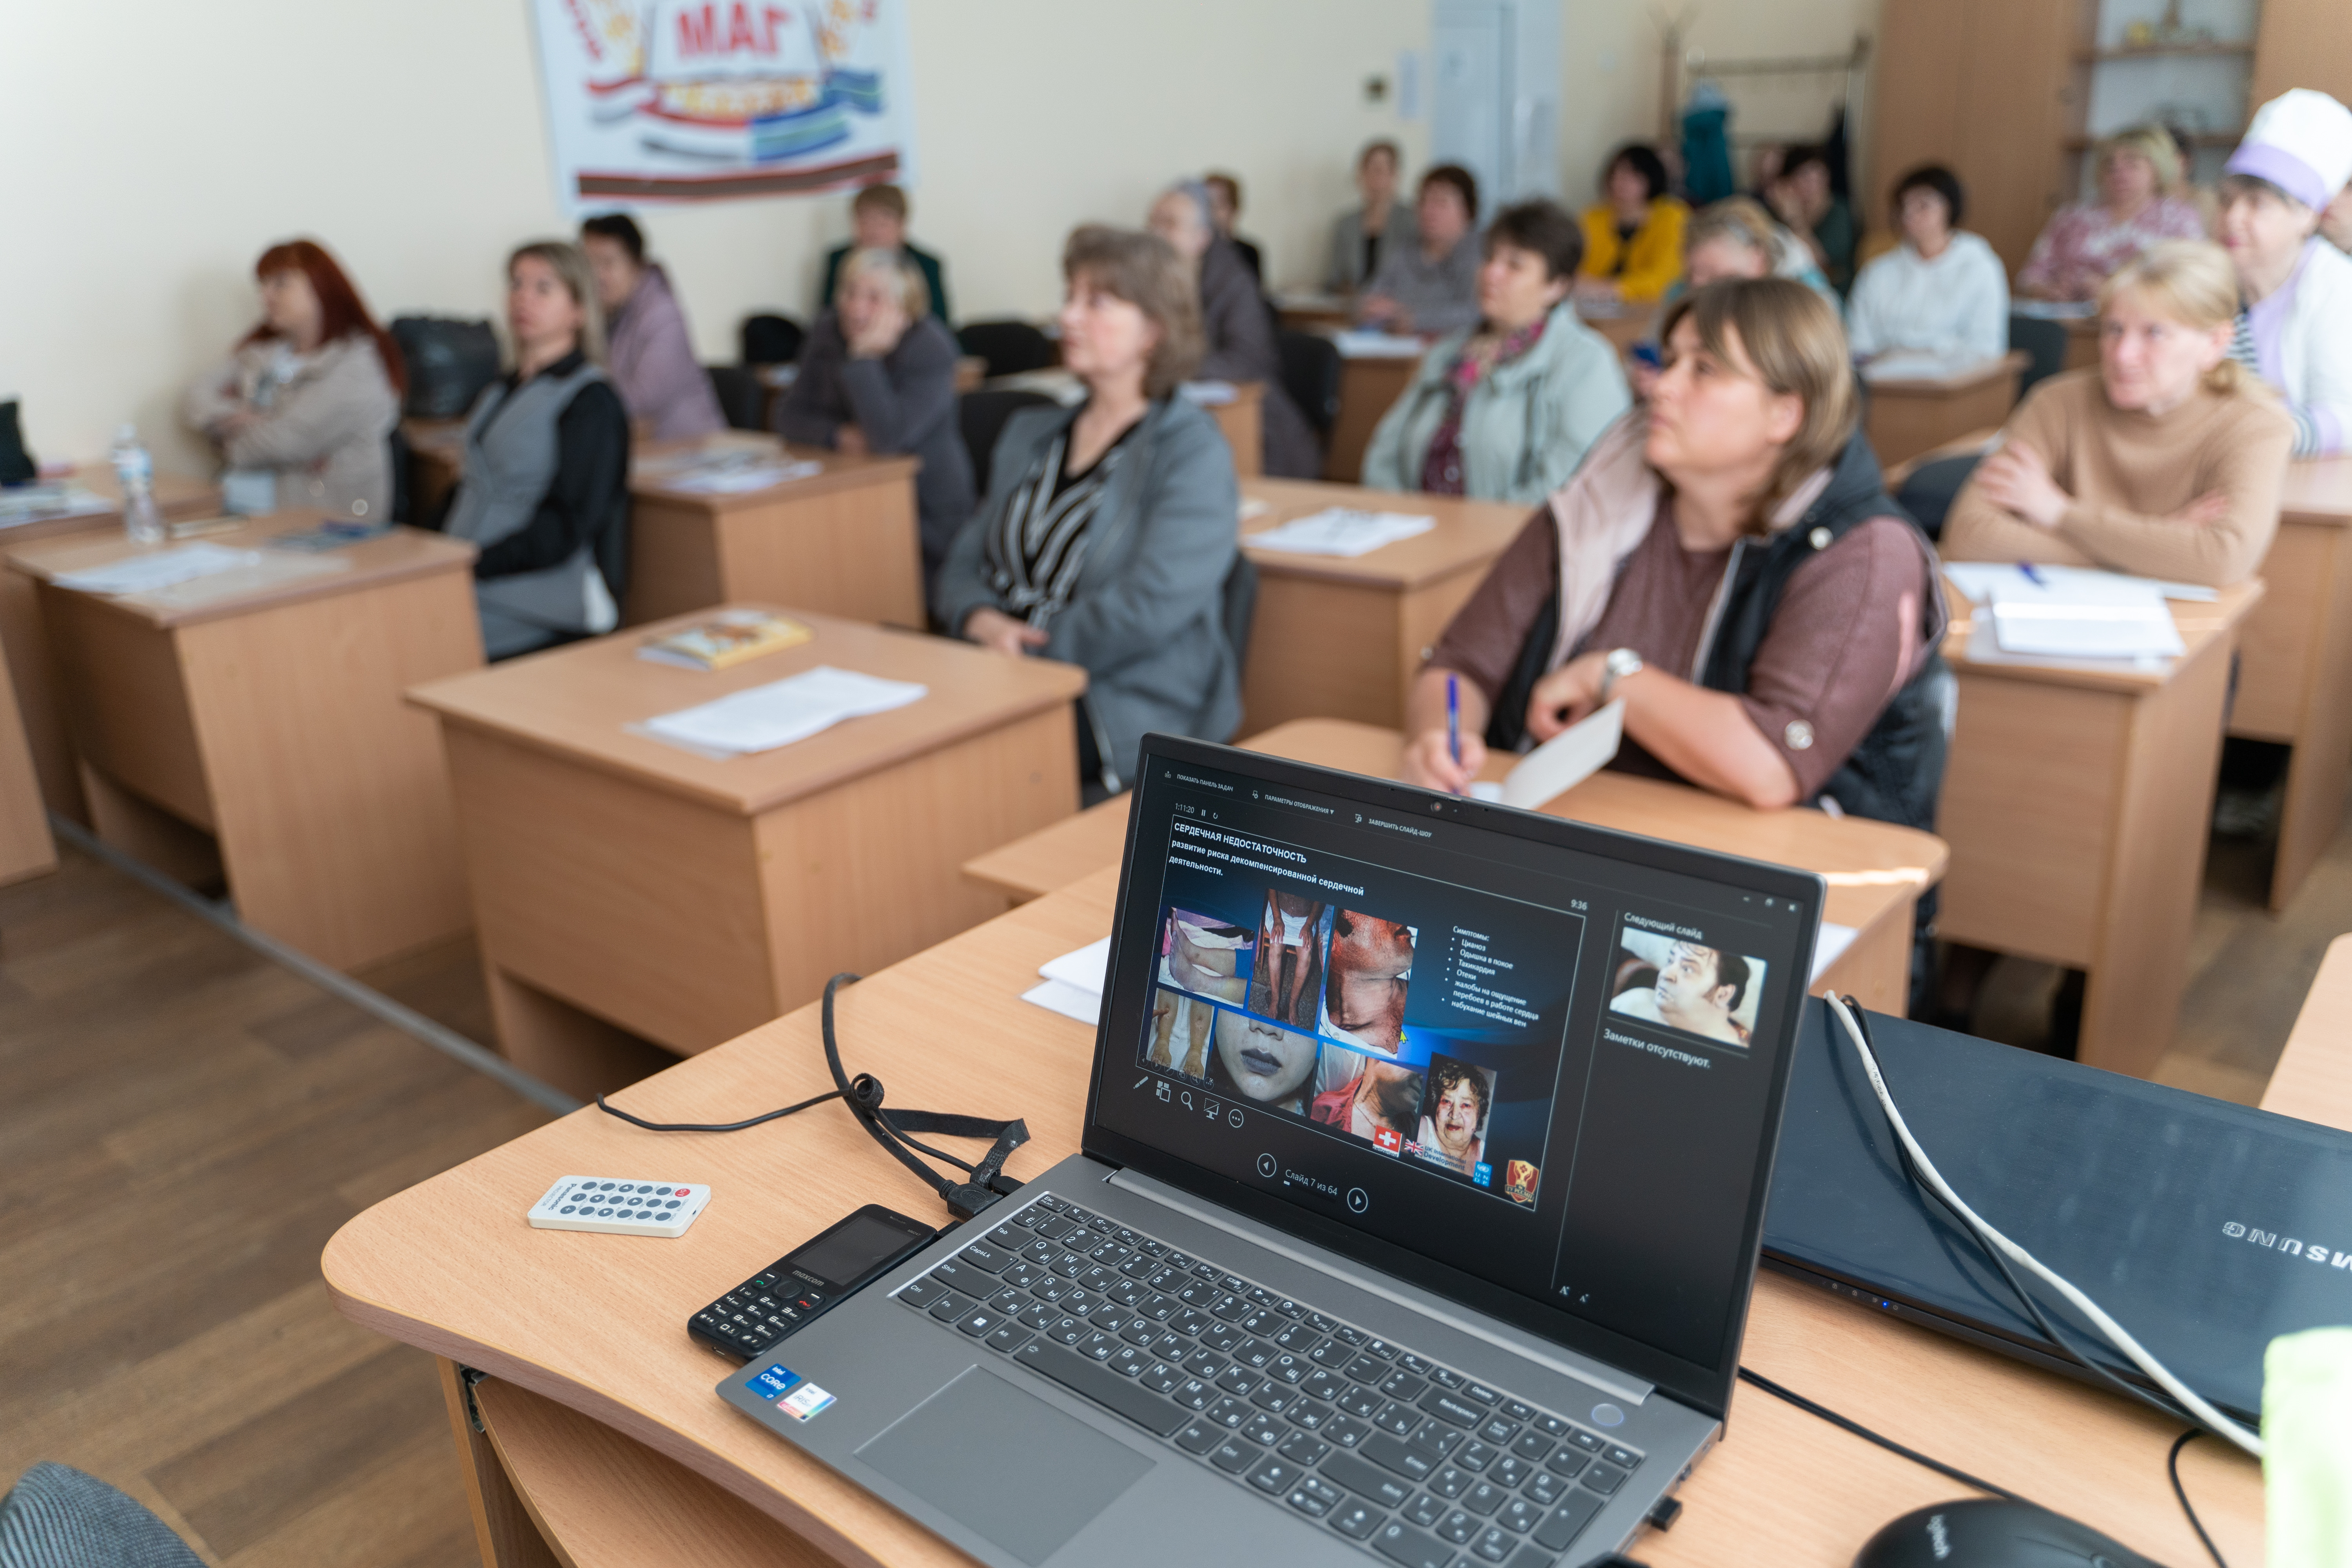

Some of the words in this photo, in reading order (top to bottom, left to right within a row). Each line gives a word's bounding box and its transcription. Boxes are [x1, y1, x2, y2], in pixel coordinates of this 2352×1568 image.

[1177, 774, 1199, 784] ПОКАЗАТЬ
[1200, 779, 1217, 788] ПАНЕЛЬ
[1175, 803, 1194, 813] 1:11:20
[1265, 794, 1293, 805] ПАРАМЕТРЫ
[1294, 802, 1329, 814] ОТОБРАЖЕНИЯ
[1368, 818, 1399, 830] ЗАВЕРШИТЬ
[1399, 825, 1432, 838] СЛАЙД-ШОУ
[1174, 823, 1221, 841] СЕРДЕЧНАЯ
[1223, 835, 1307, 863] НЕДОСТАТОЧНОСТЬ
[1169, 856, 1223, 876] деятельности.
[1172, 840, 1206, 854] развитие
[1207, 849, 1229, 860] риска
[1230, 855, 1317, 884] декомпенсированной
[1319, 878, 1364, 896] сердечной
[1571, 899, 1588, 910] 9:36
[1624, 912, 1675, 931] Следующий
[1676, 926, 1702, 940] слайд
[1453, 926, 1490, 941] Симптомы:
[1461, 939, 1486, 951] Цианоз
[1460, 949, 1486, 962] Одышка
[1493, 959, 1514, 969] покое
[1459, 959, 1496, 975] Тахикардия
[1457, 969, 1477, 980] Отеки
[1454, 981, 1481, 992] жалобы
[1491, 991, 1526, 1006] ощущение
[1454, 990, 1484, 1004] перебоев
[1490, 1001, 1514, 1013] работе
[1514, 1007, 1539, 1020] сердца
[1452, 1000, 1485, 1015] набухание
[1486, 1011, 1513, 1023] шейных
[1514, 1019, 1526, 1027] вен
[1604, 1028, 1644, 1049] Заметки
[1646, 1043, 1711, 1069] отсутствуют.
[1373, 1145, 1397, 1157] Switzerland
[1434, 1149, 1466, 1164] International
[1424, 1151, 1465, 1171] Development
[1286, 1170, 1308, 1186] Слайд
[1317, 1183, 1326, 1191] из
[1328, 1185, 1338, 1195] 64
[548, 1183, 577, 1210] Panasonic
[970, 1246, 991, 1258] CapsLk
[1065, 1254, 1078, 1263] W
[942, 1265, 956, 1273] Shift
[1164, 1335, 1176, 1343] H
[1252, 1355, 1264, 1363] Ш
[772, 1367, 786, 1375] intel
[1229, 1367, 1241, 1376] K
[1287, 1369, 1298, 1379] Щ
[1263, 1383, 1271, 1392] L
[1472, 1387, 1492, 1398] Delete
[1440, 1399, 1477, 1419] Backspace
[1303, 1415, 1318, 1425] Ж
[1489, 1425, 1505, 1436] Lock
[1492, 1422, 1508, 1432] Num
[1406, 1457, 1427, 1470] Enter
